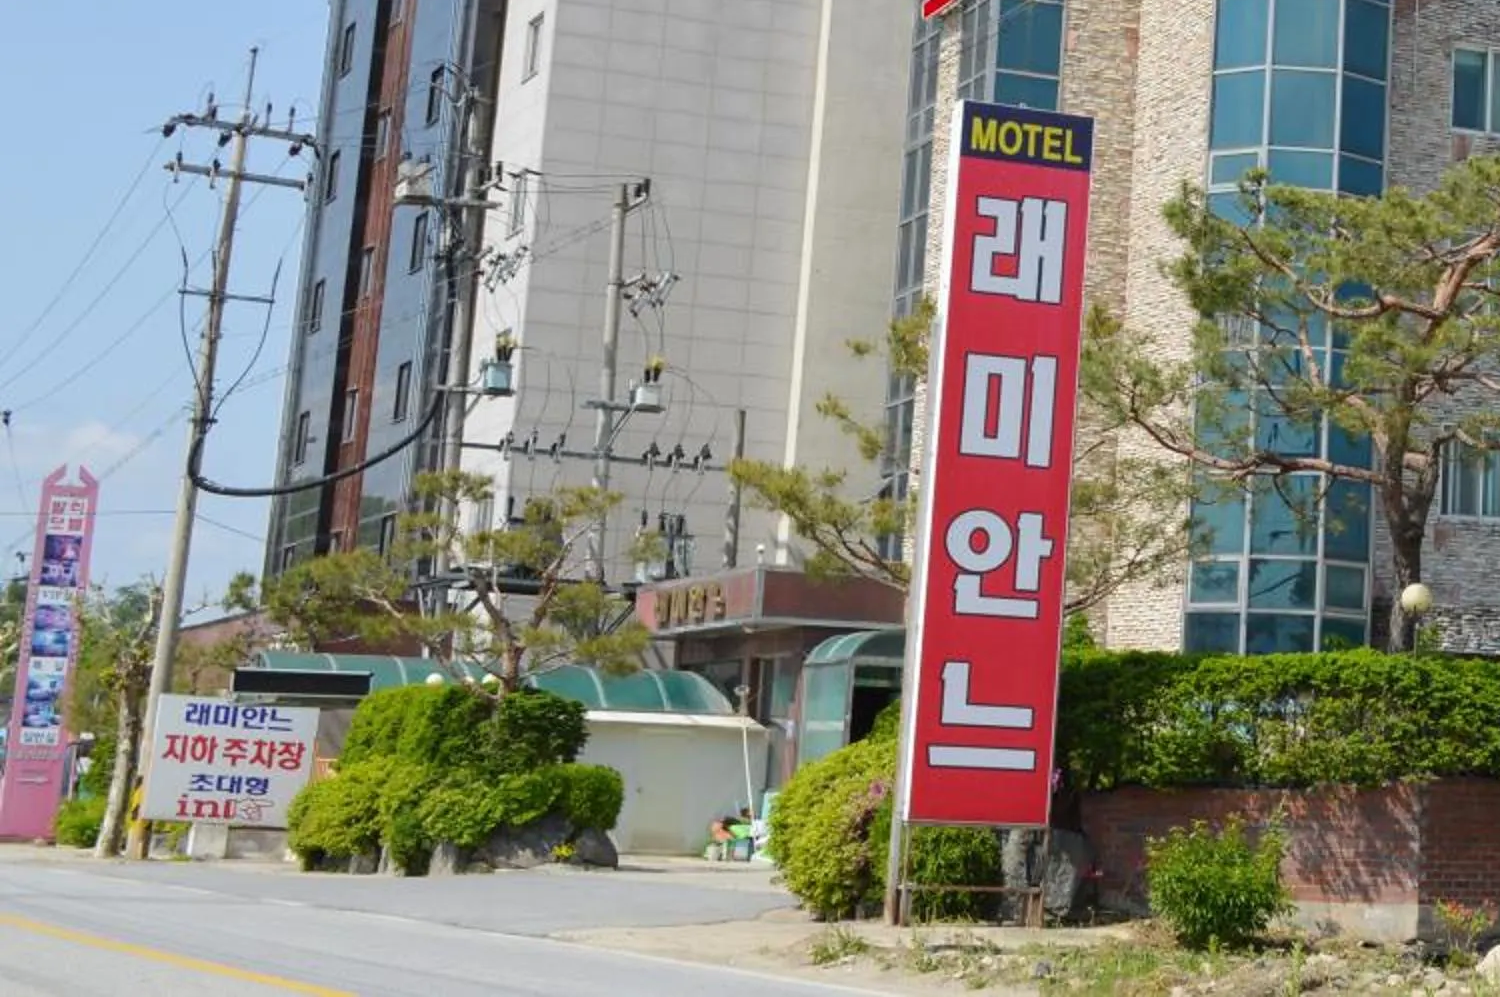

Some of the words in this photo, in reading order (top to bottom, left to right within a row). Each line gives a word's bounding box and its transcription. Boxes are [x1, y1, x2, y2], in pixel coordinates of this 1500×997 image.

[970, 117, 1083, 165] MOTEL
[927, 195, 1067, 773] 래미안느
[184, 703, 293, 732] 래미안느
[162, 734, 219, 765] 지하
[222, 738, 306, 770] 주차장
